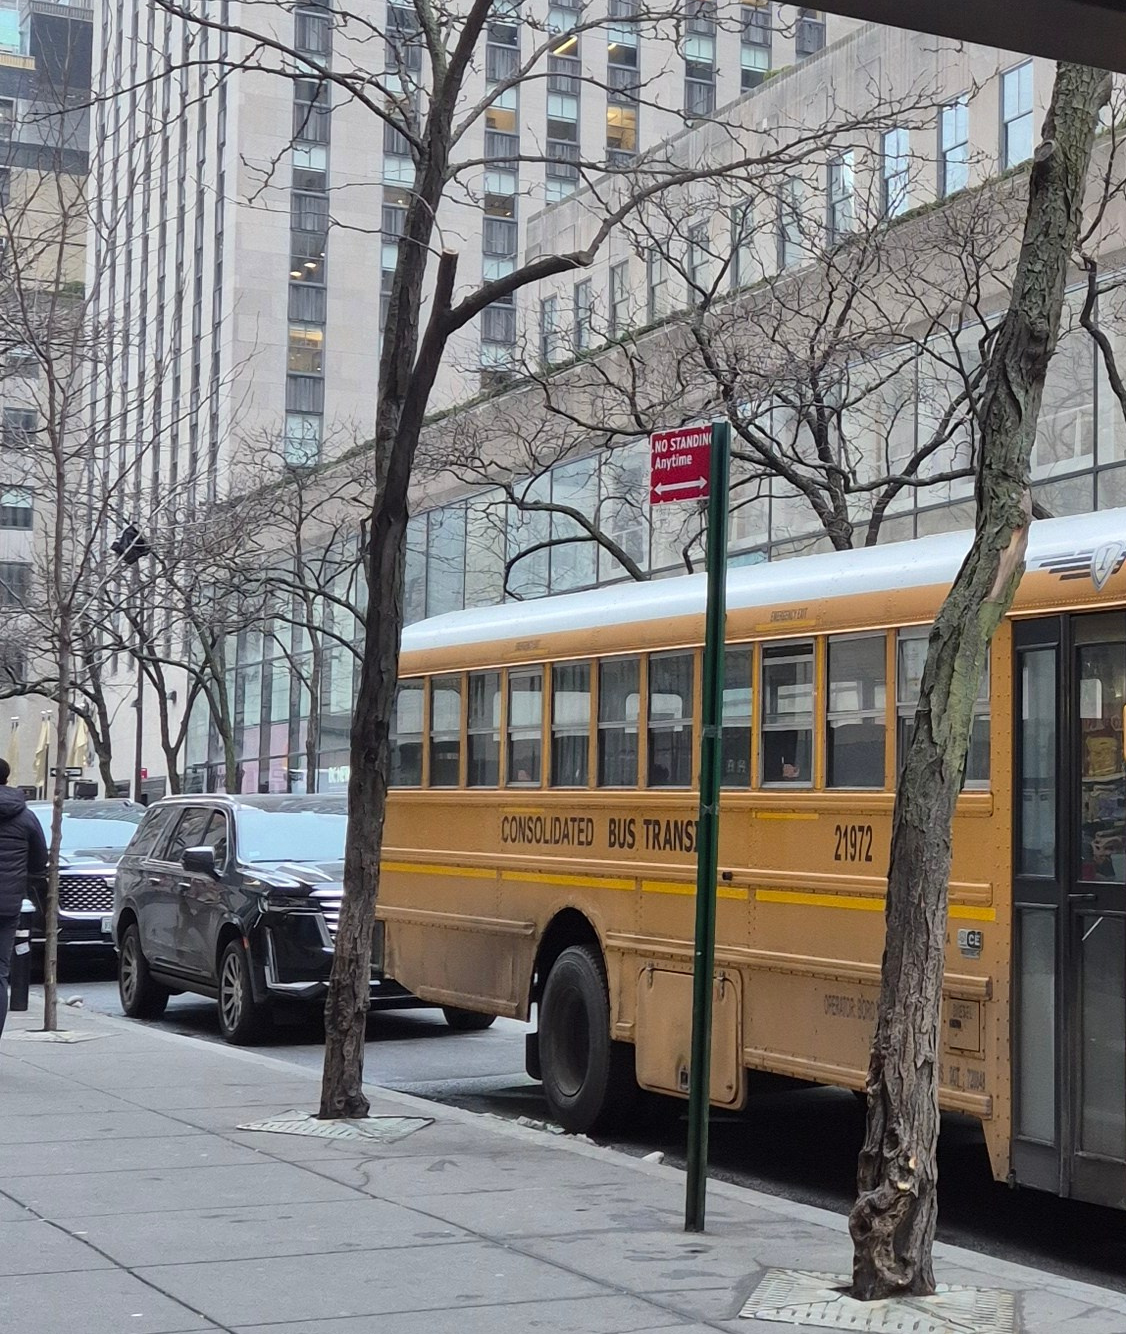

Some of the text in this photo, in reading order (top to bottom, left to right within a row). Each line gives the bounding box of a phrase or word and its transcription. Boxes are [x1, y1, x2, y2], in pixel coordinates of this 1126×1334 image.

[655, 439, 669, 454] NO
[655, 454, 693, 472] Anytime
[501, 816, 595, 847] CONSOLIDATED
[608, 818, 637, 850] BUS
[834, 824, 873, 862] 21972
